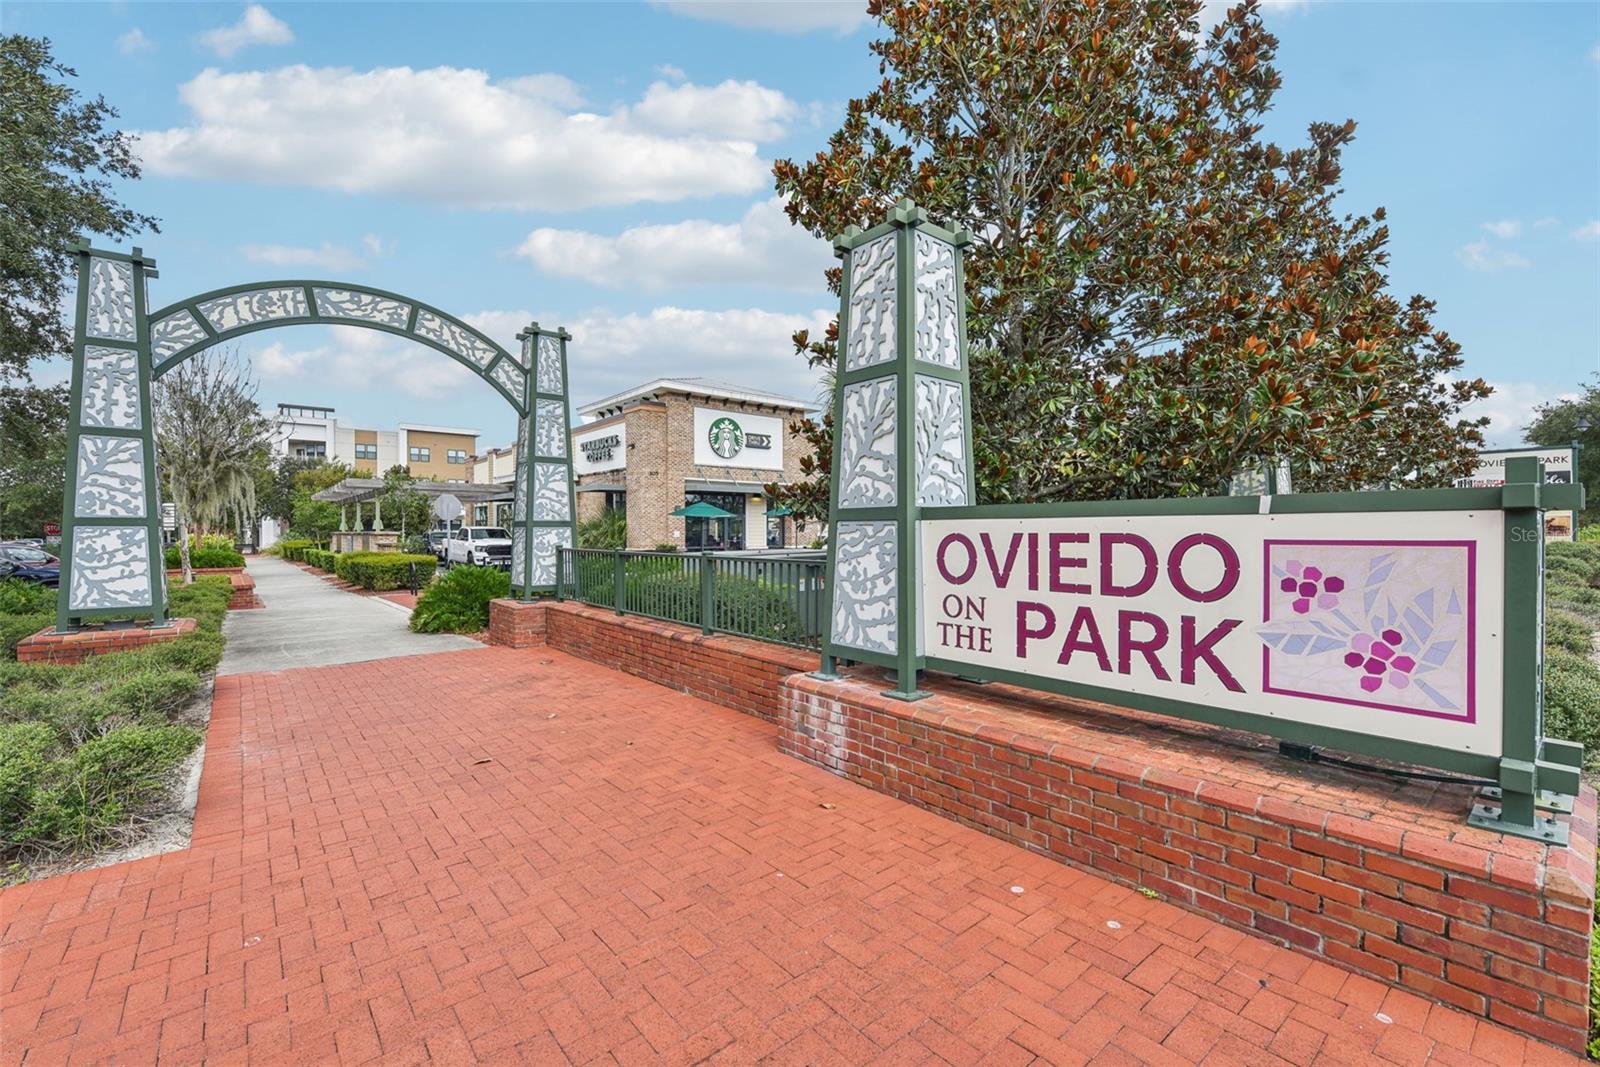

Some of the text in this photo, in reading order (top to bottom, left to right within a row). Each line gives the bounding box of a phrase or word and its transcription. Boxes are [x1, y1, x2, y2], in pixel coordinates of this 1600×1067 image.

[1478, 459, 1505, 468] OVIE
[936, 532, 1241, 603] OVIEDO
[942, 593, 987, 622] ON
[937, 621, 993, 654] THE
[1016, 600, 1248, 694] PARK
